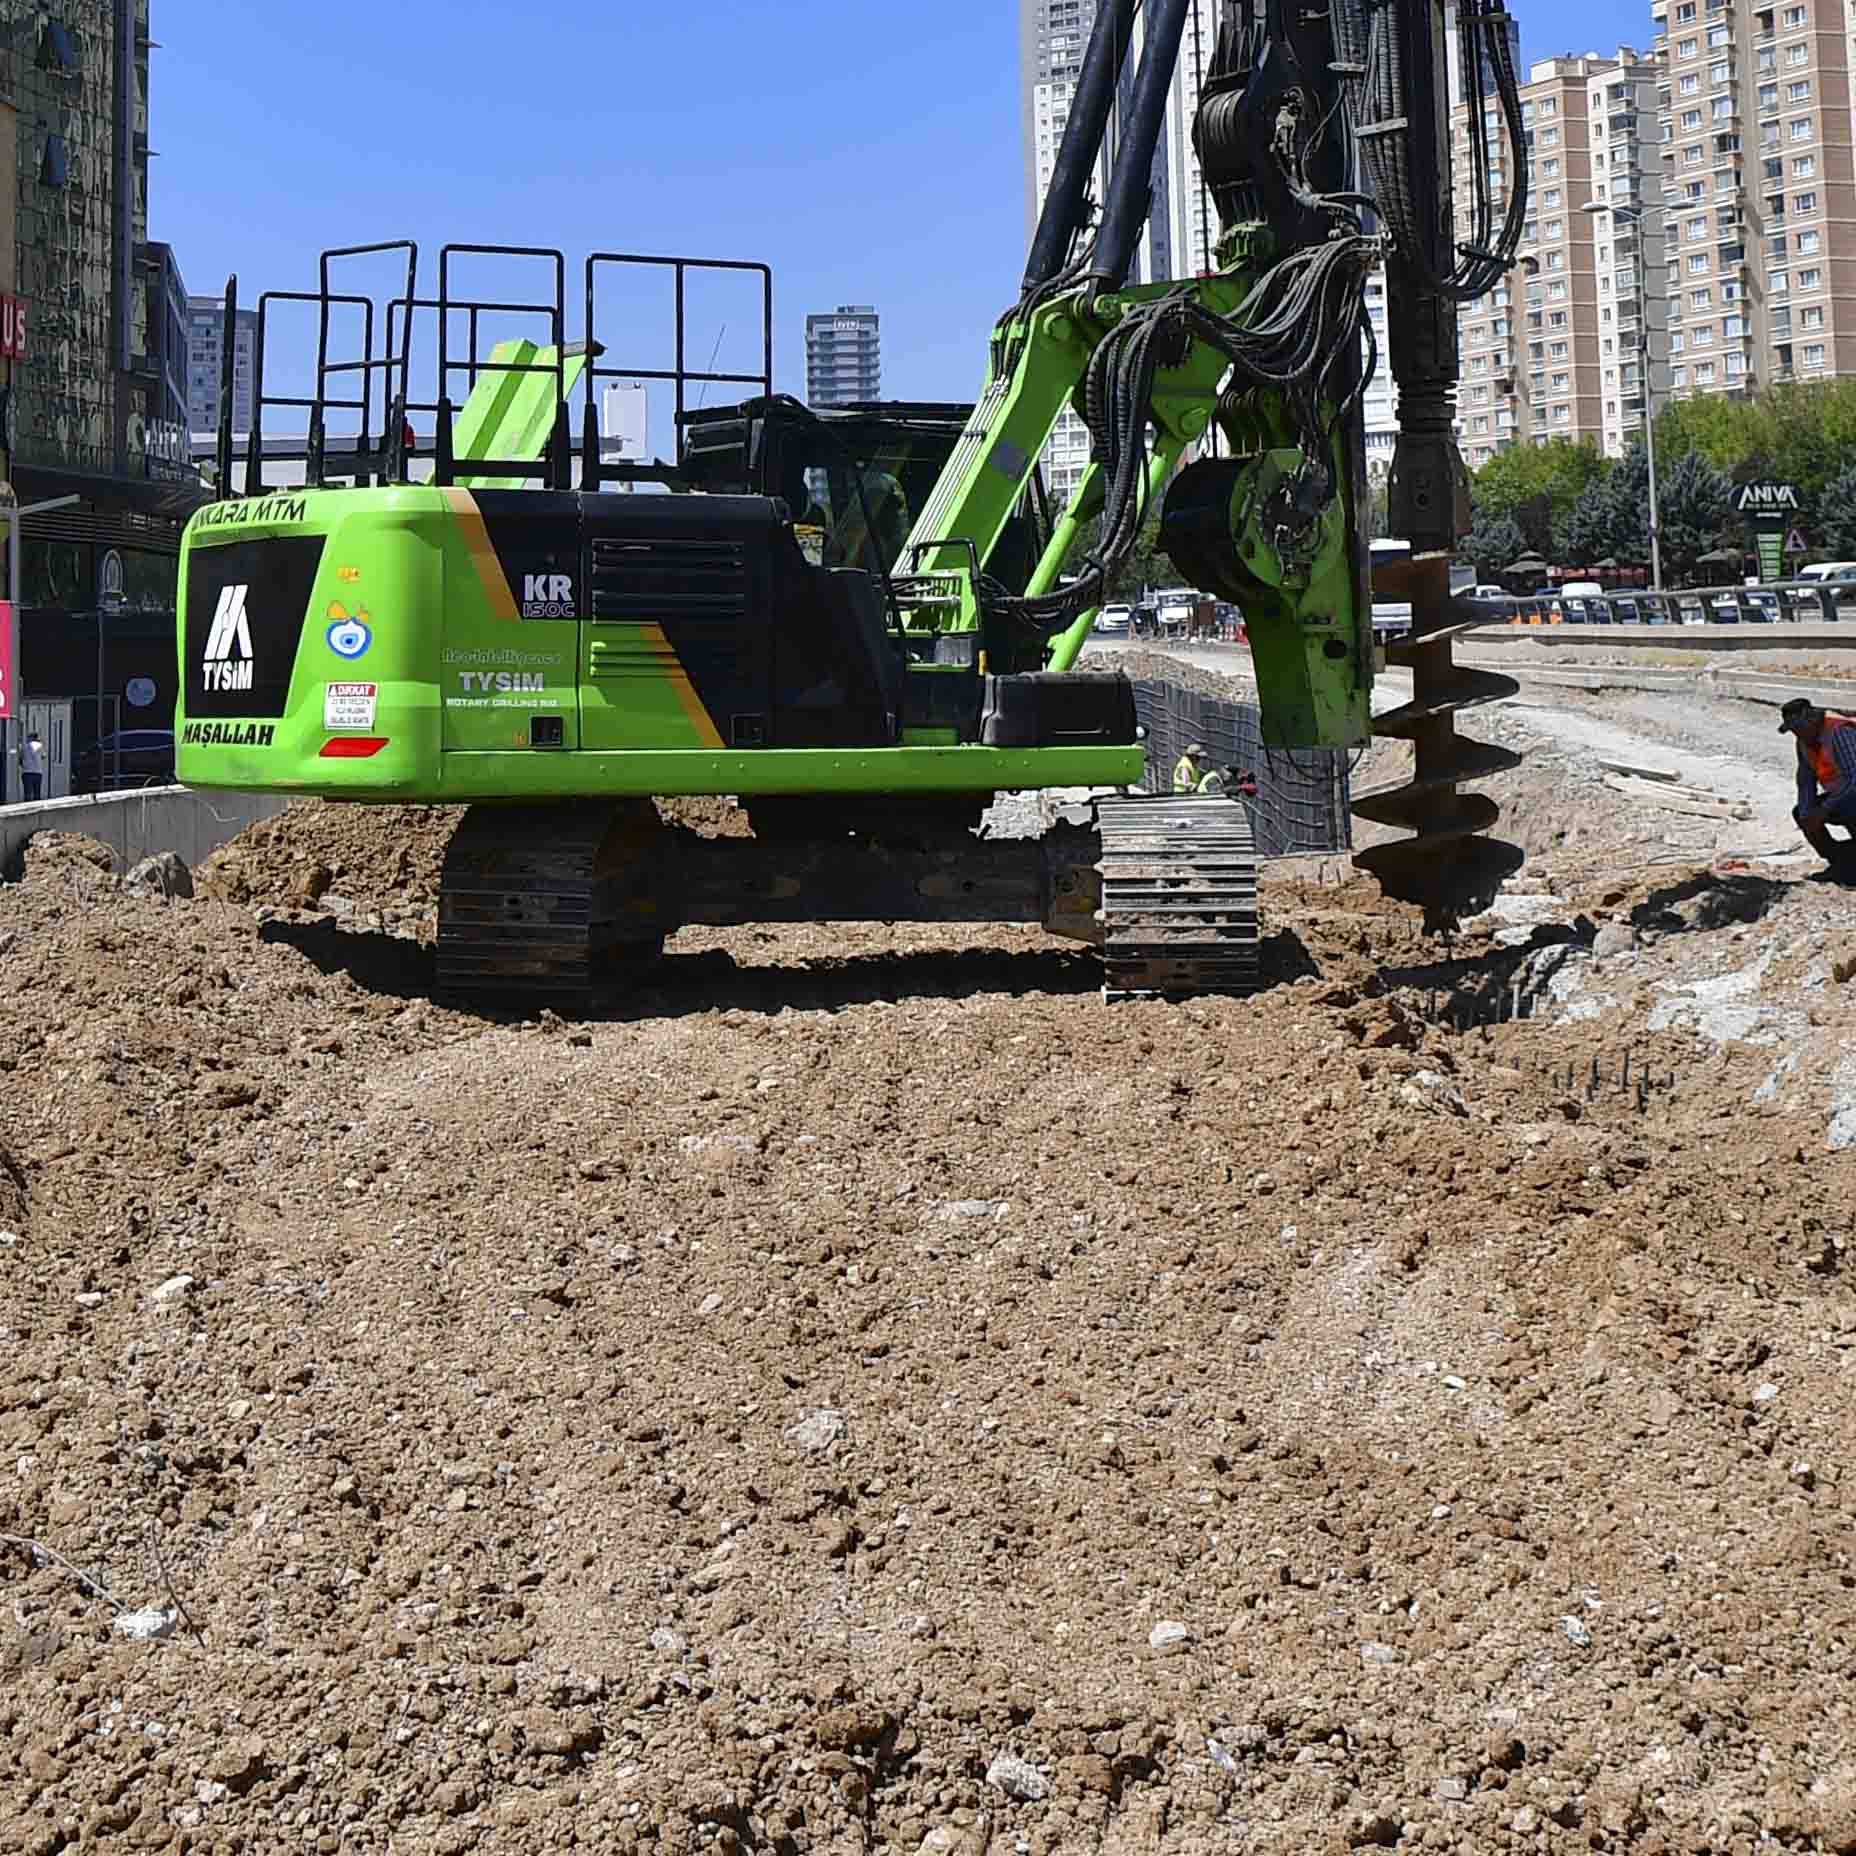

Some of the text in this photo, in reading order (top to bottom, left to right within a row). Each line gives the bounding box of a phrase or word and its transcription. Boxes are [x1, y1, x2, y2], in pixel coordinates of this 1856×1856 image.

[251, 498, 307, 522] MTM
[524, 574, 573, 601] KR
[181, 722, 276, 749] MAŞALLAH
